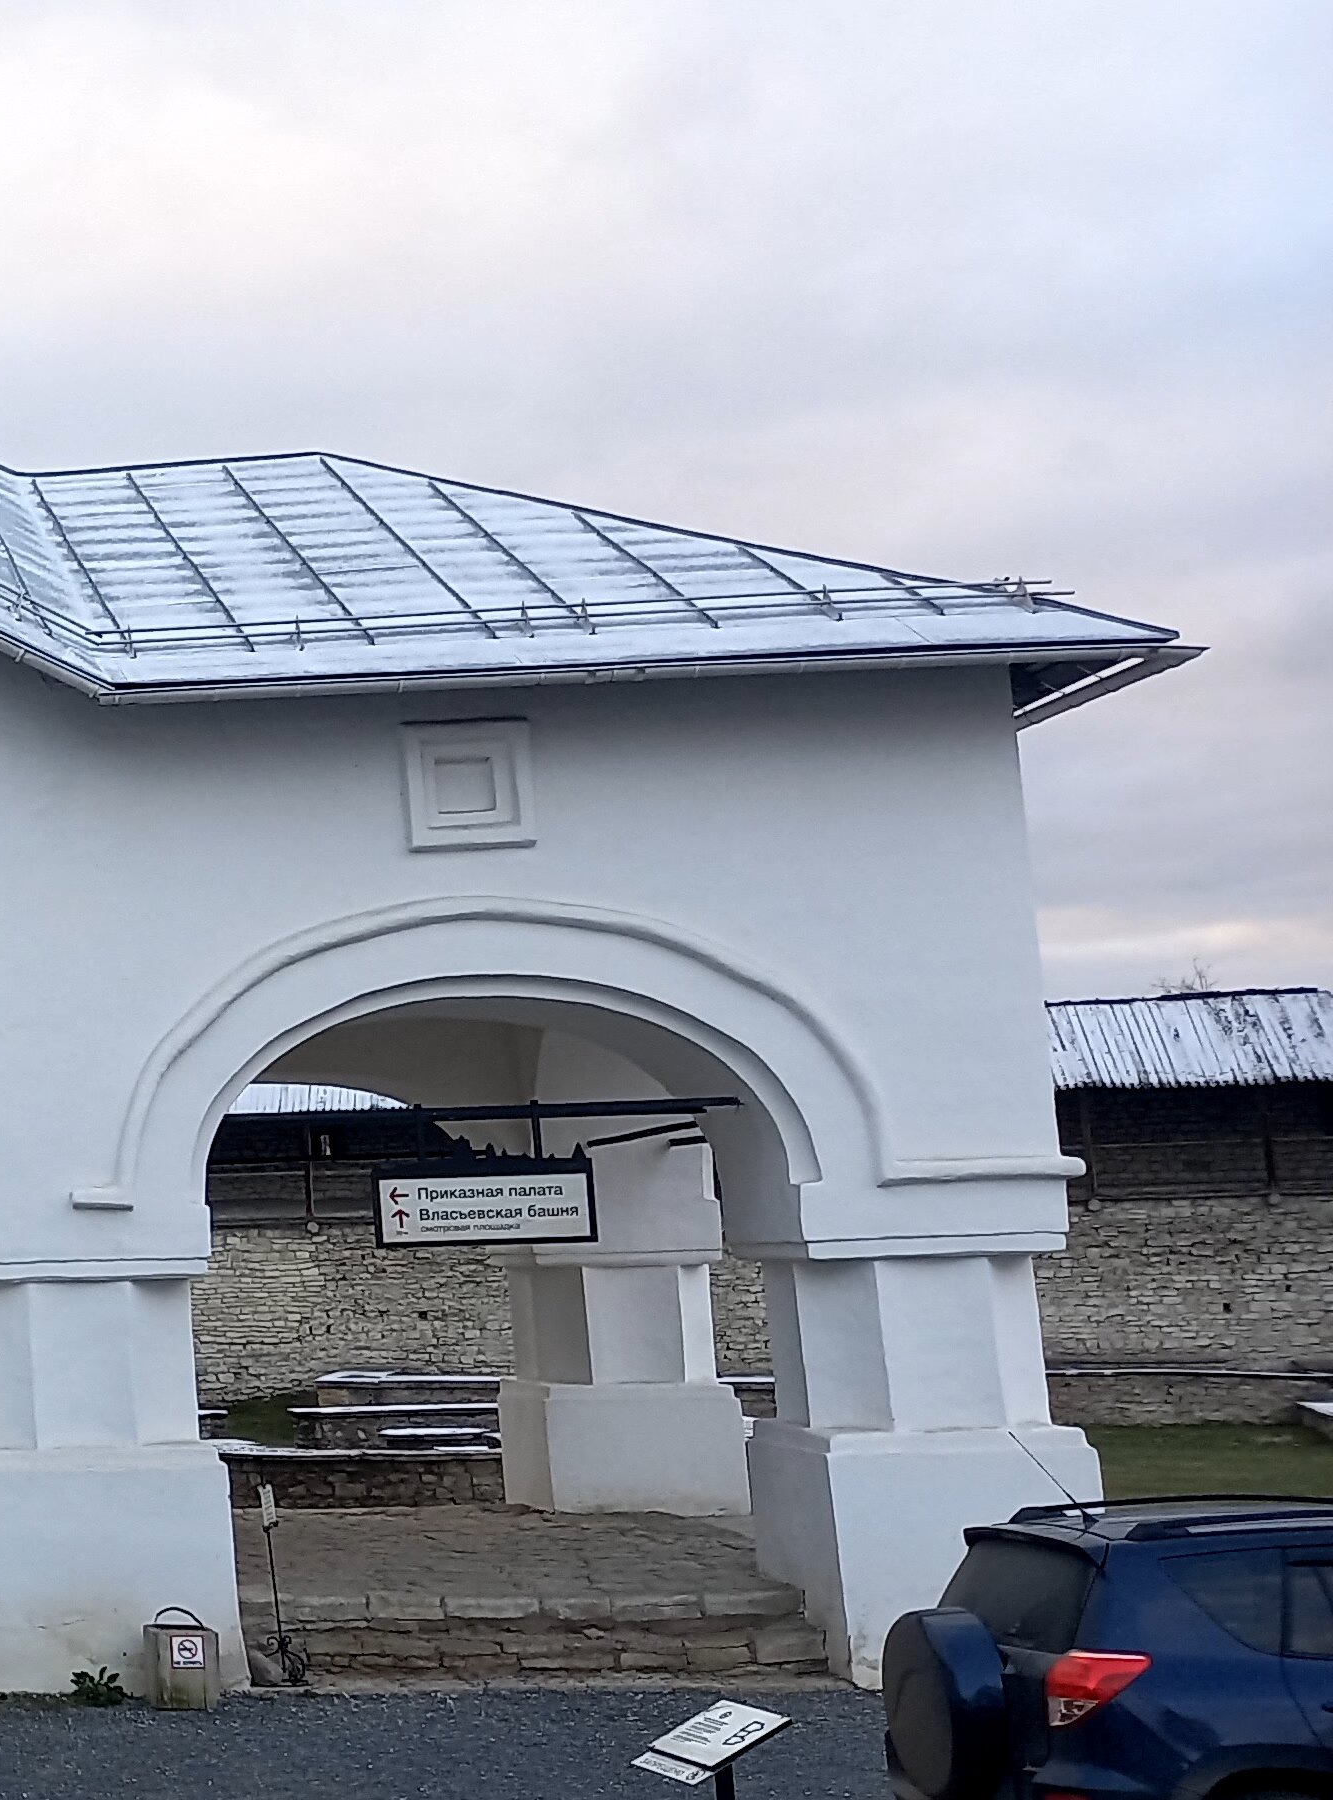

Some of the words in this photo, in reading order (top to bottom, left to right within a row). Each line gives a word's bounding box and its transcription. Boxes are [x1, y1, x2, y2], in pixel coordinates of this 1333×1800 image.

[416, 1186, 504, 1203] Приказная
[508, 1184, 564, 1198] палата
[419, 1208, 523, 1221] Власьевская
[527, 1204, 579, 1218] башня
[420, 1224, 471, 1234] смотровая
[473, 1223, 521, 1232] площадка
